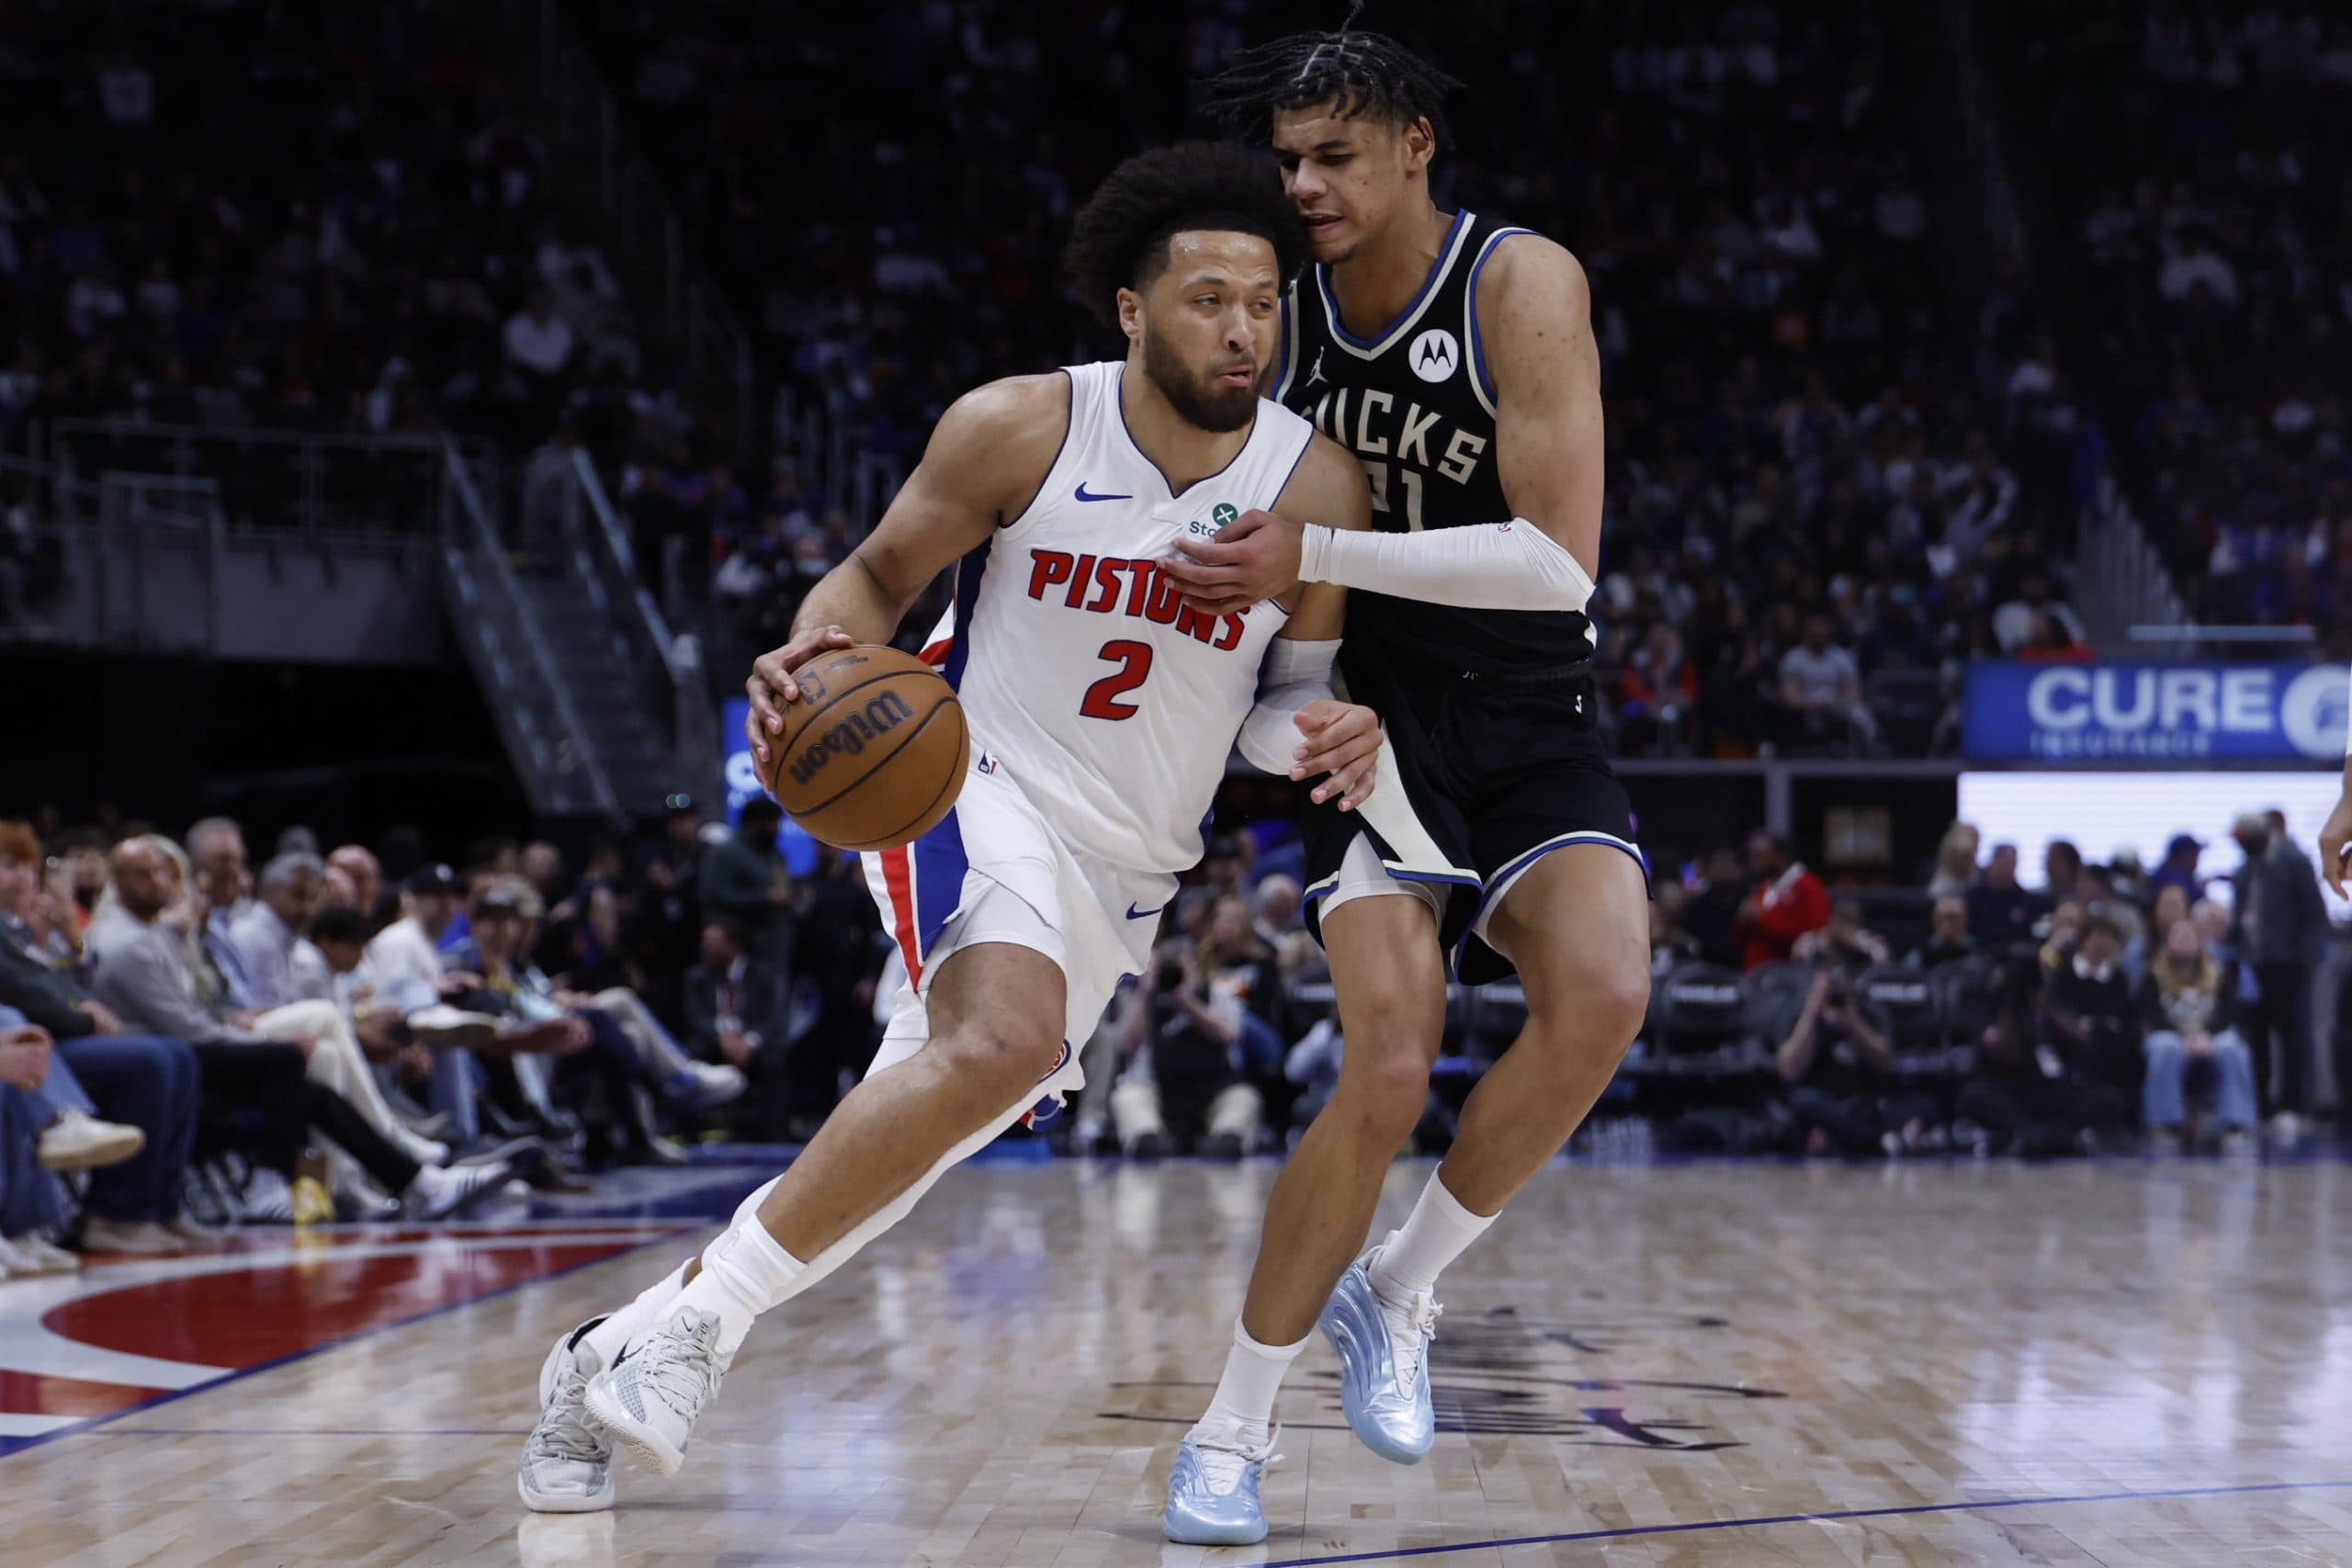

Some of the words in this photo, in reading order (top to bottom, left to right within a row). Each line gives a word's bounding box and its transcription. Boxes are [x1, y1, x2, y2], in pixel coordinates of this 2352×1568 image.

[1301, 388, 1487, 486] UCKS
[1079, 638, 1154, 721] 2
[2027, 665, 2272, 731] CURE
[790, 689, 913, 784] Wilson
